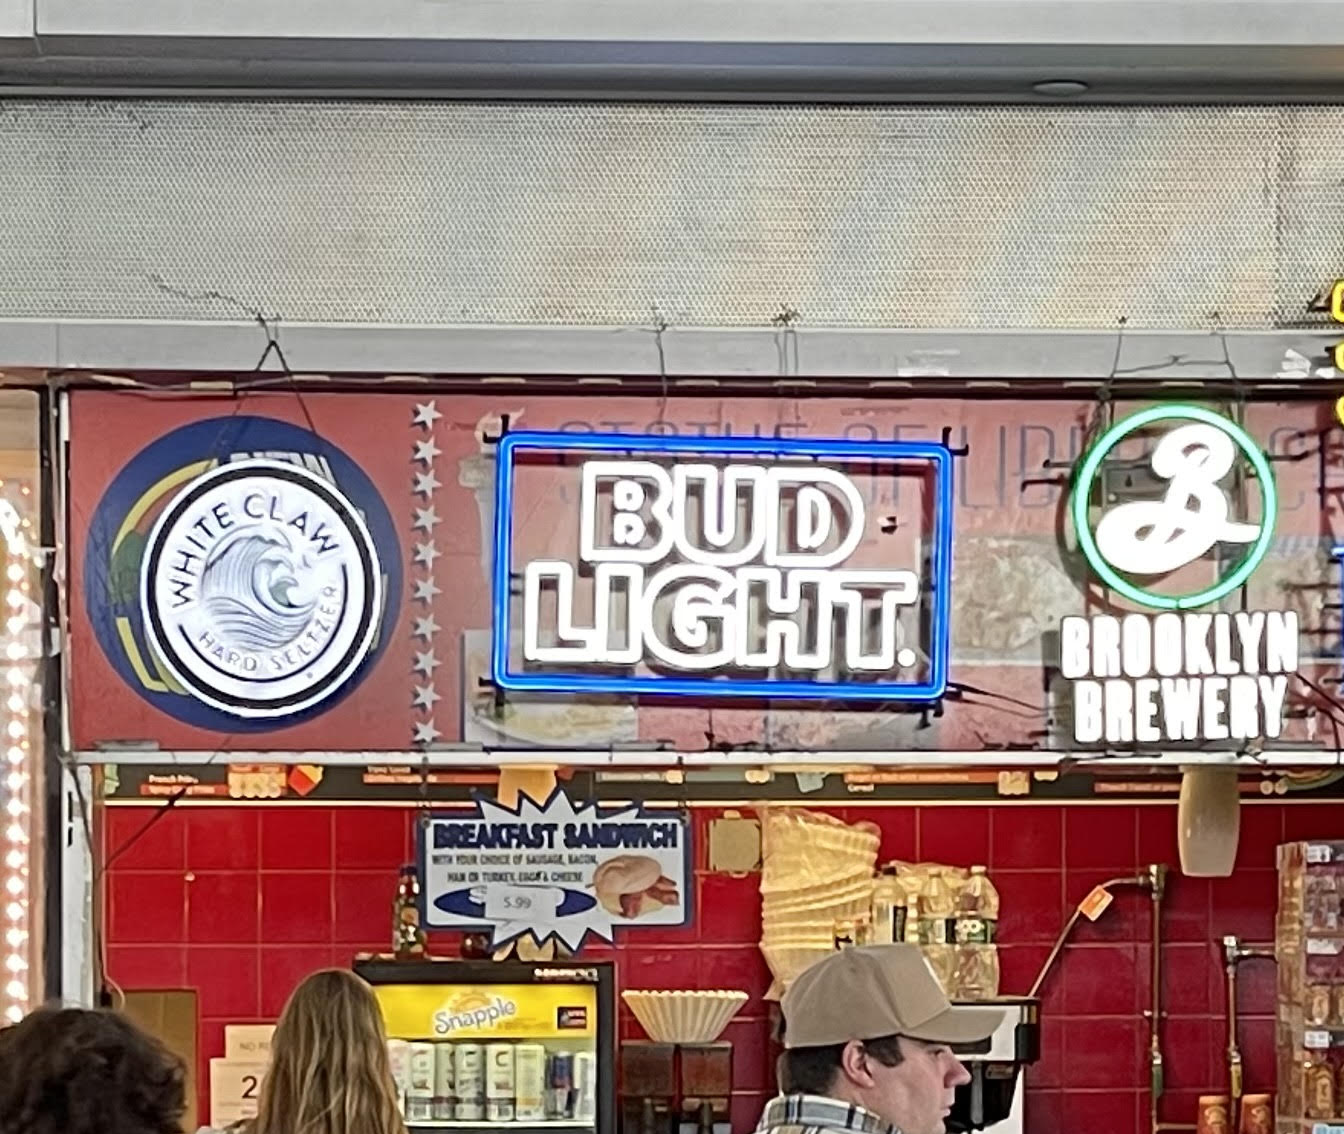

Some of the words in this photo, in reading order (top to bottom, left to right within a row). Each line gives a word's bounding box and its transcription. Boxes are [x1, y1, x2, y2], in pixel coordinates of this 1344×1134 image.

[580, 460, 865, 568] BUD
[172, 502, 234, 608] WHITE
[243, 493, 340, 554] CLAW
[198, 630, 258, 672] HARD
[270, 585, 338, 672] SELTZER
[524, 558, 919, 671] LIGHT.
[1061, 611, 1298, 679] BROOKLYN
[1073, 675, 1288, 743] BREWERY
[432, 854, 452, 865] WITH
[456, 854, 477, 865] YOUR
[480, 854, 510, 865] CHOICE
[513, 854, 523, 865] OF
[433, 823, 557, 848] BREAKFAST
[563, 822, 678, 849] SANDWICH
[551, 872, 583, 882] CHEESE
[434, 997, 517, 1035] Snapple
